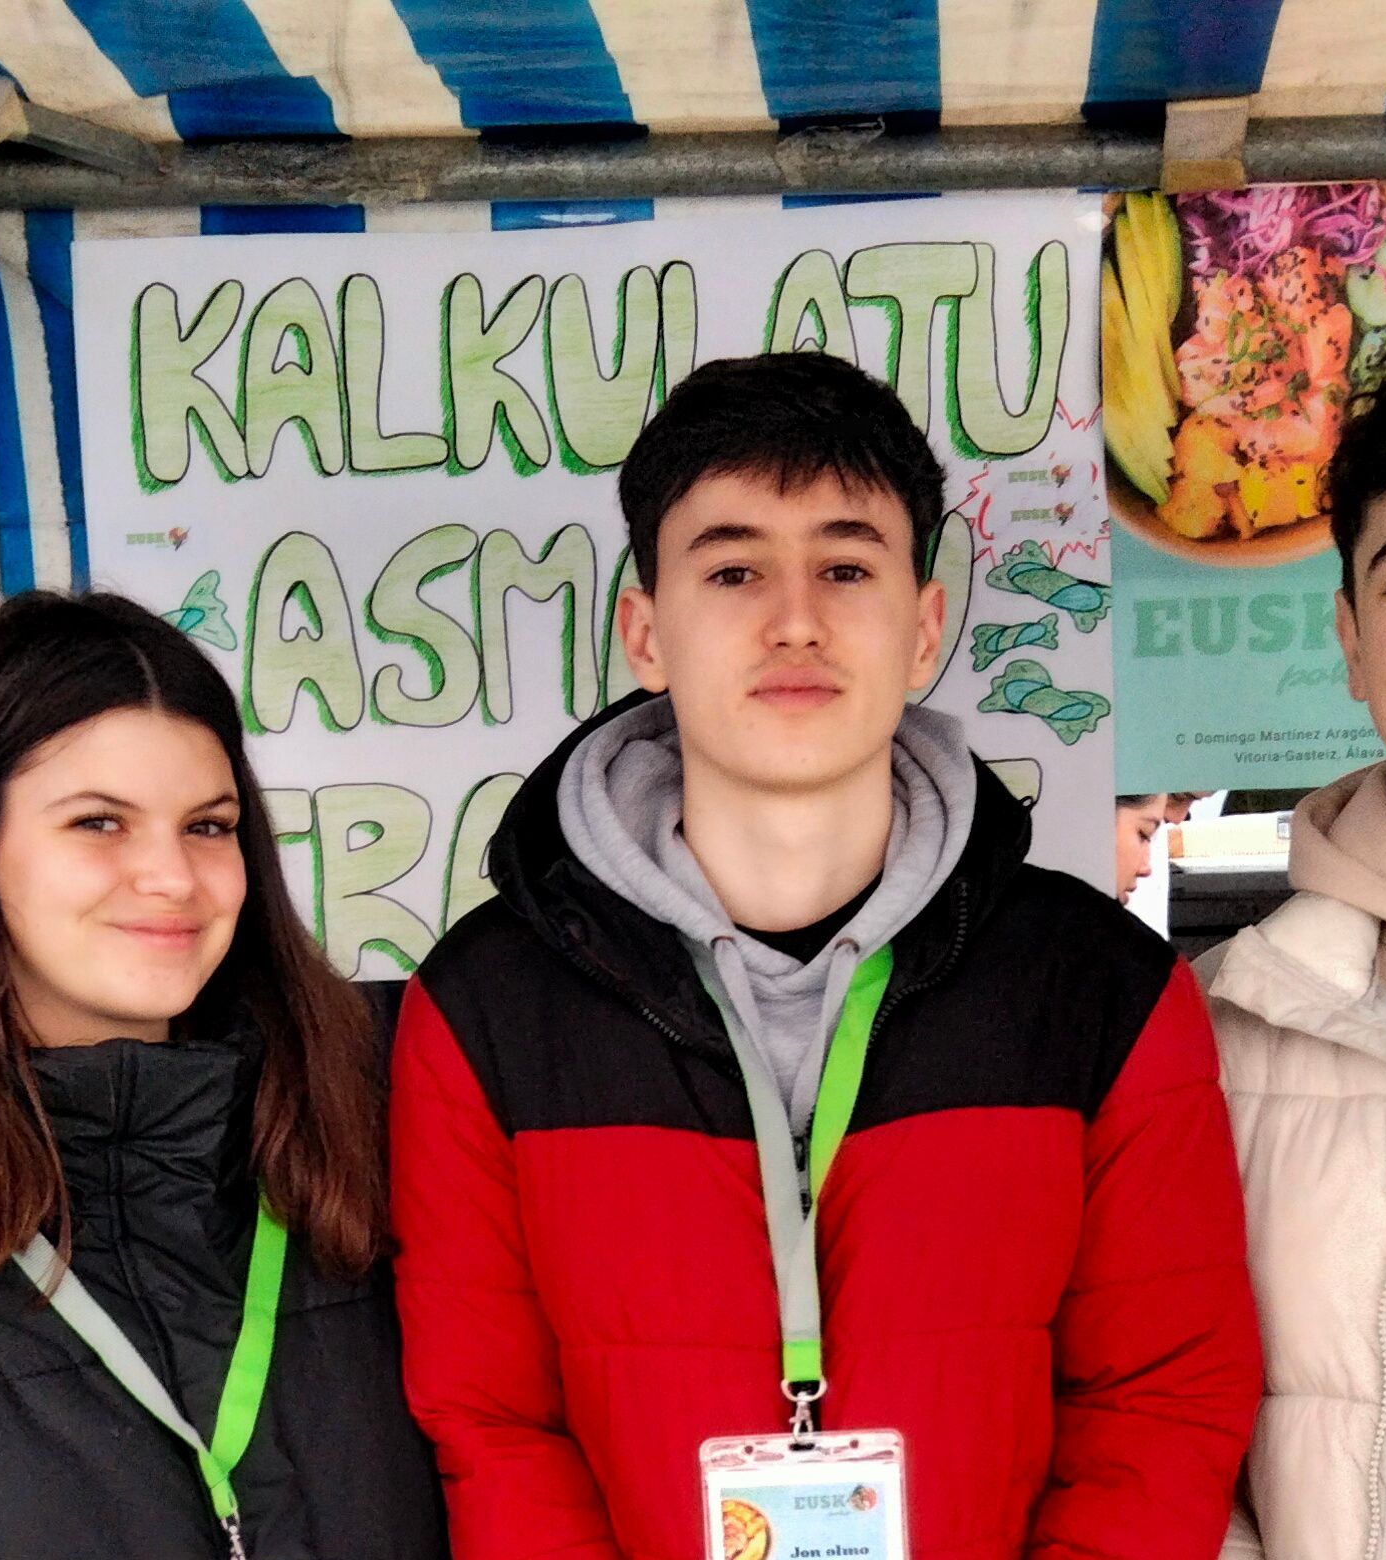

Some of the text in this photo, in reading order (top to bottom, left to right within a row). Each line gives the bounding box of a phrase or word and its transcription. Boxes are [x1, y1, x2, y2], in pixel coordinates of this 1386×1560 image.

[1194, 729, 1256, 746] Domingo
[794, 1494, 847, 1511] EUSK
[790, 1546, 821, 1559] Jon
